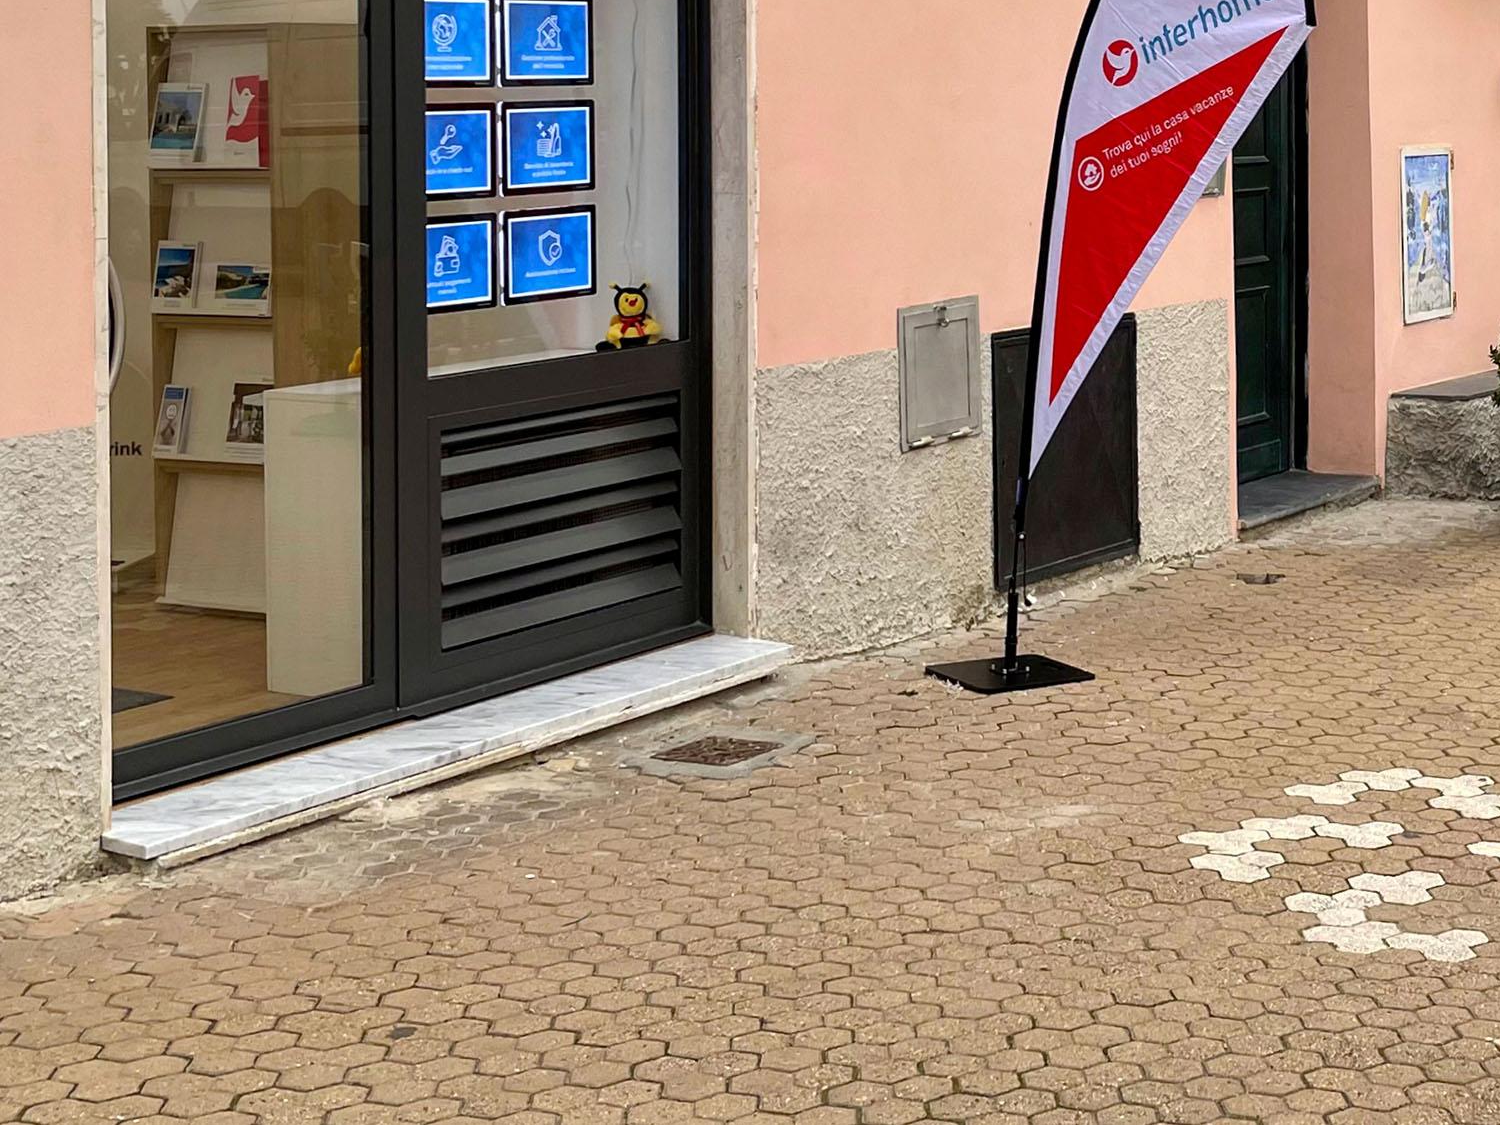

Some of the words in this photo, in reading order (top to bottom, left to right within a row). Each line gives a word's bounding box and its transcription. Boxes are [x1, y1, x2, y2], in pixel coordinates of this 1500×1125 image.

[1102, 141, 1133, 161] Trova
[1133, 130, 1151, 147] qui
[1151, 123, 1163, 137] la
[1163, 110, 1190, 130] casa
[1189, 85, 1235, 116] vacanze
[1110, 160, 1128, 178] dei
[1127, 151, 1151, 169] tuoi
[1151, 131, 1183, 157] sogni!
